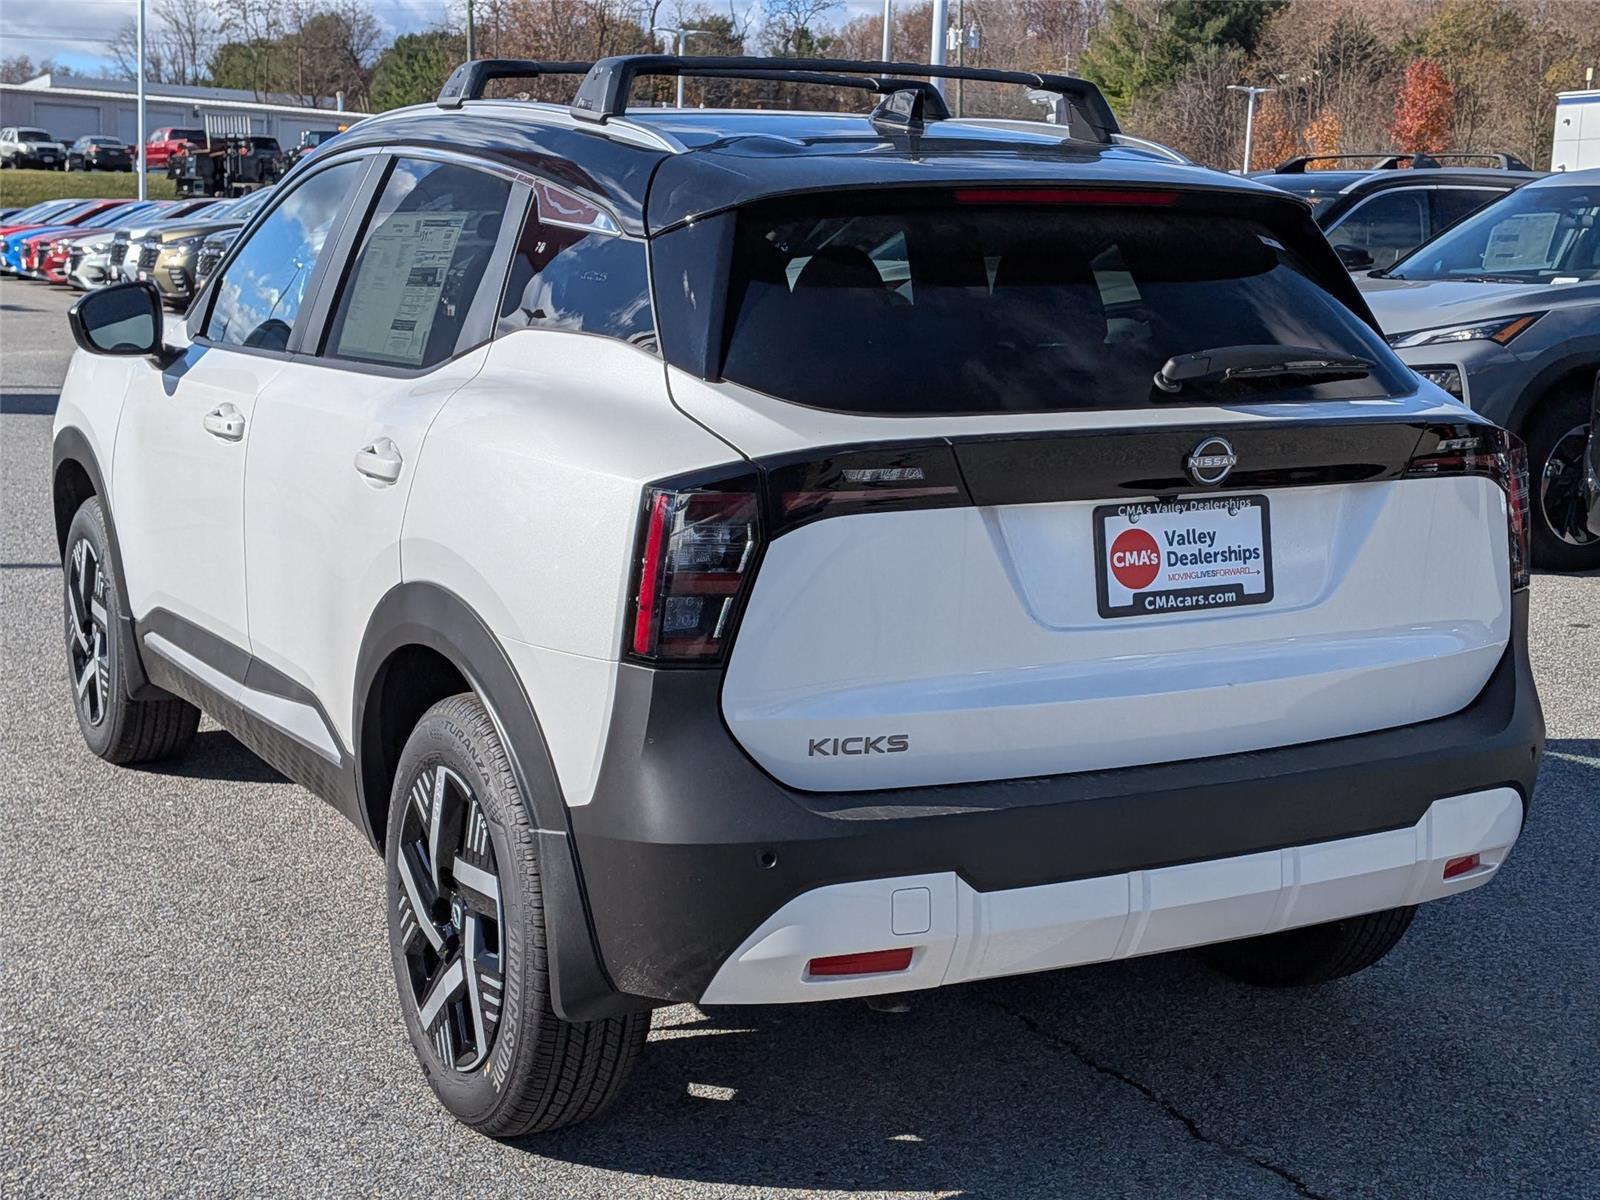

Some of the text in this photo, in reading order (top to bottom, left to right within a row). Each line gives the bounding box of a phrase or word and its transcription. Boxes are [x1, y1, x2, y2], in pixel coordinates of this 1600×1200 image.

[1189, 456, 1236, 466] NISSAN
[1118, 498, 1251, 516] CMA's Valley Dealerships
[1164, 528, 1217, 548] Valley
[1113, 550, 1159, 568] CMA's
[1166, 545, 1260, 567] Dealerships
[1144, 591, 1237, 610] CMAcars.com
[441, 720, 491, 787] TURANZA
[808, 734, 909, 757] KICKS
[490, 925, 522, 1094] BRIDGESTONE
